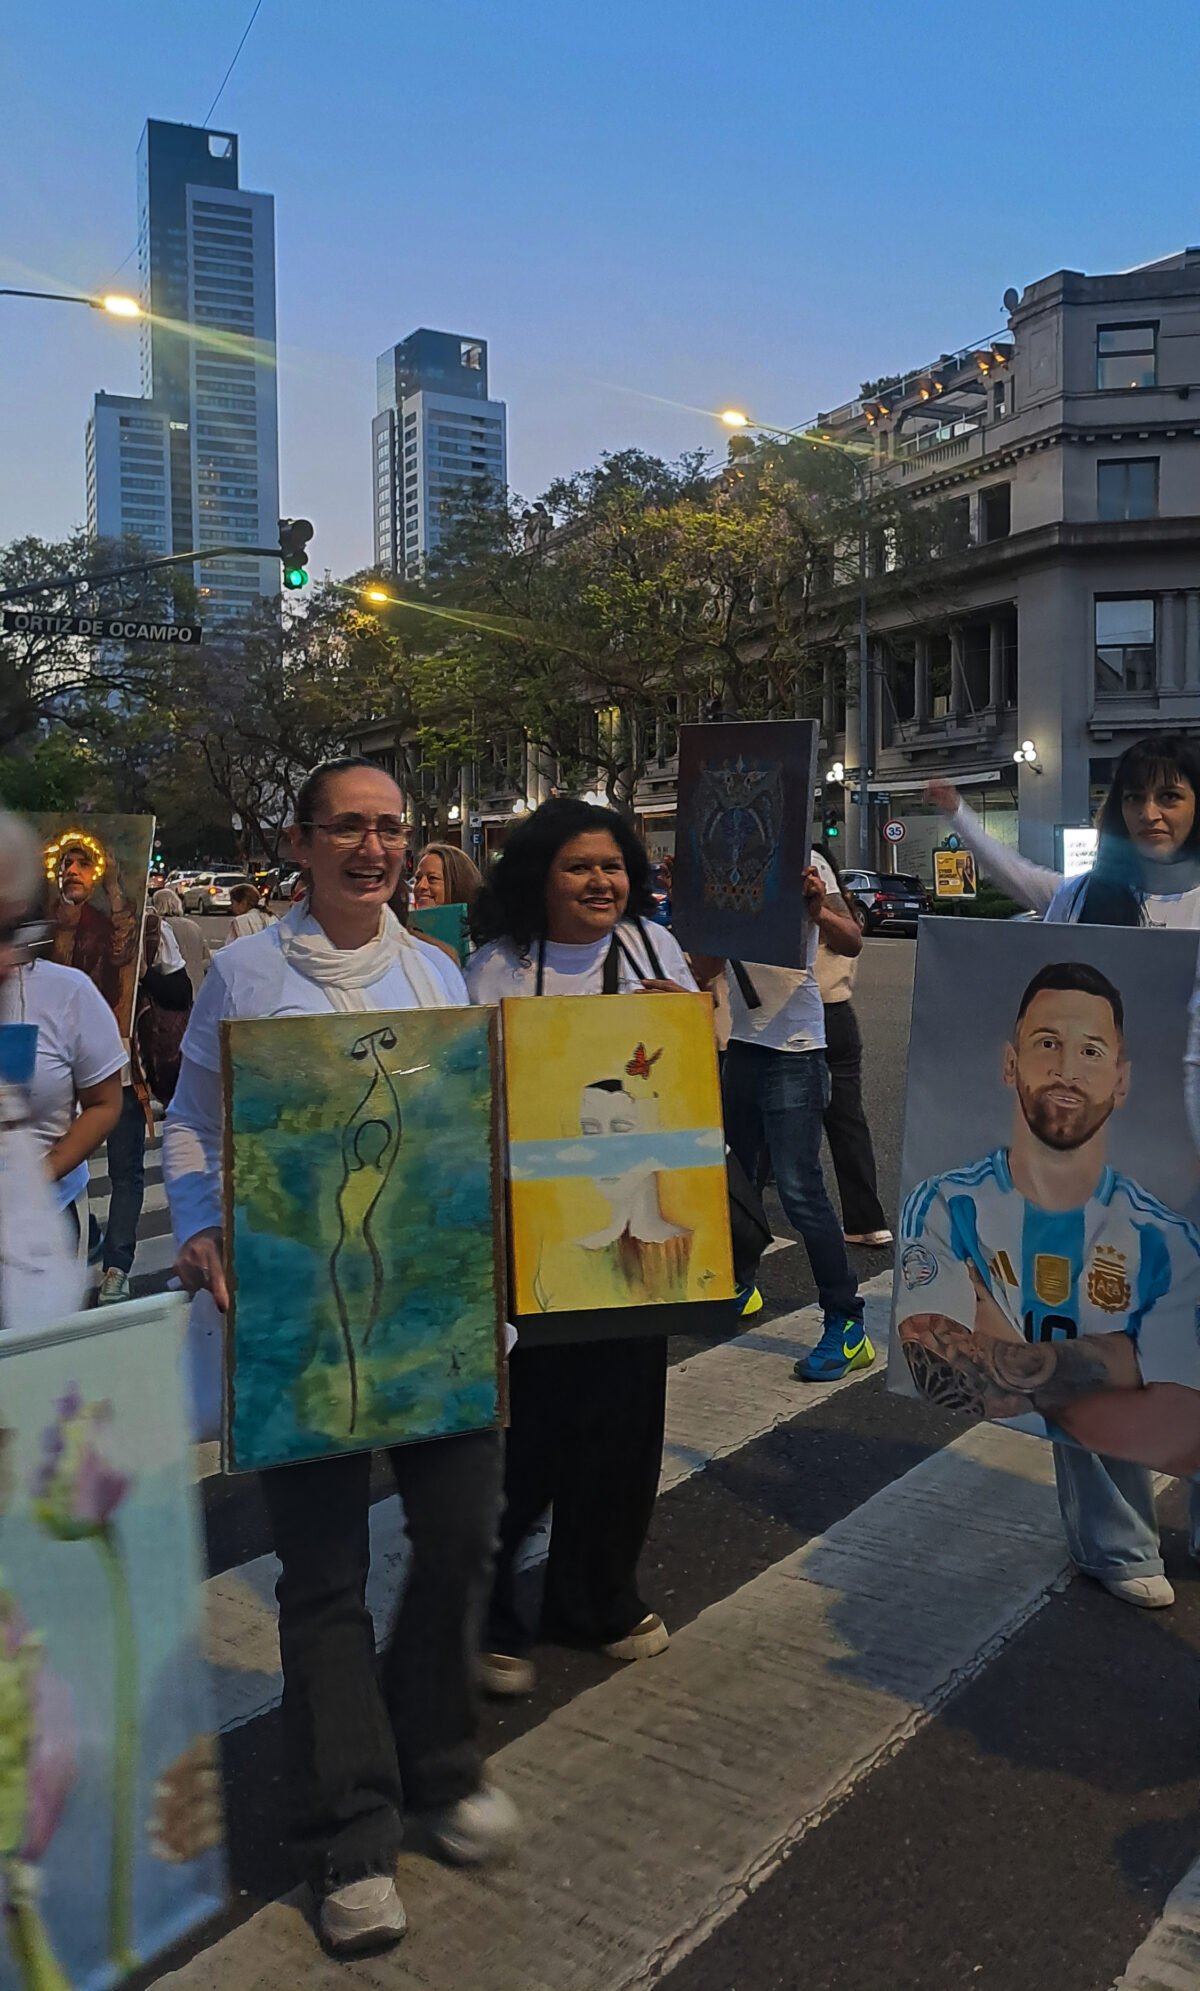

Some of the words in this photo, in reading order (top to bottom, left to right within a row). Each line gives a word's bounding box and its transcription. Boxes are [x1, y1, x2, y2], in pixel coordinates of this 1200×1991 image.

[14, 614, 72, 633] ORTIZ
[78, 619, 103, 635] DE
[109, 622, 192, 642] OCAMPO
[888, 826, 902, 836] 35
[473, 833, 480, 844] E
